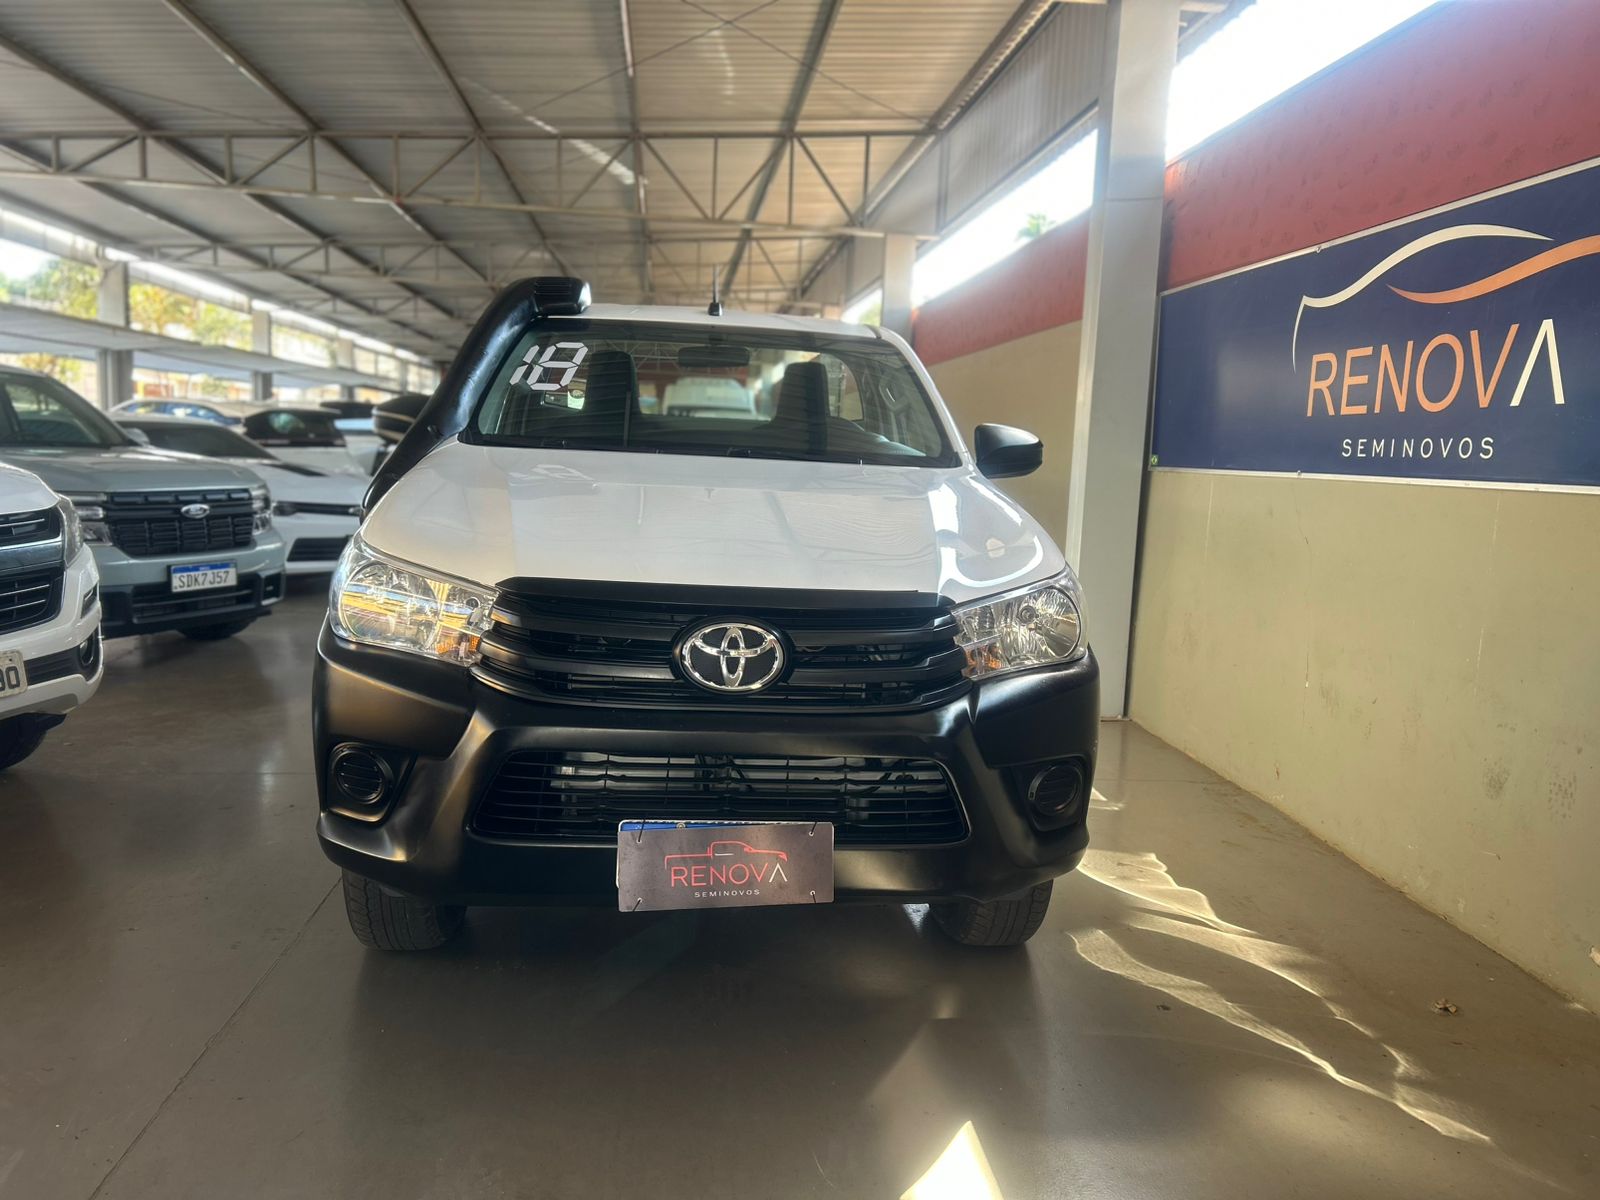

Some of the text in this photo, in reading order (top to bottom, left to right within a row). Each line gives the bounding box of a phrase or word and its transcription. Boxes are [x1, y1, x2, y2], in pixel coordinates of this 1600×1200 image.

[509, 341, 589, 391] 18
[1306, 318, 1566, 417] RENOVA
[1341, 436, 1494, 459] SEMINOVOS
[178, 571, 230, 589] SDK7J57
[670, 862, 788, 888] RENOVA
[694, 888, 761, 898] SEMINOVOS
